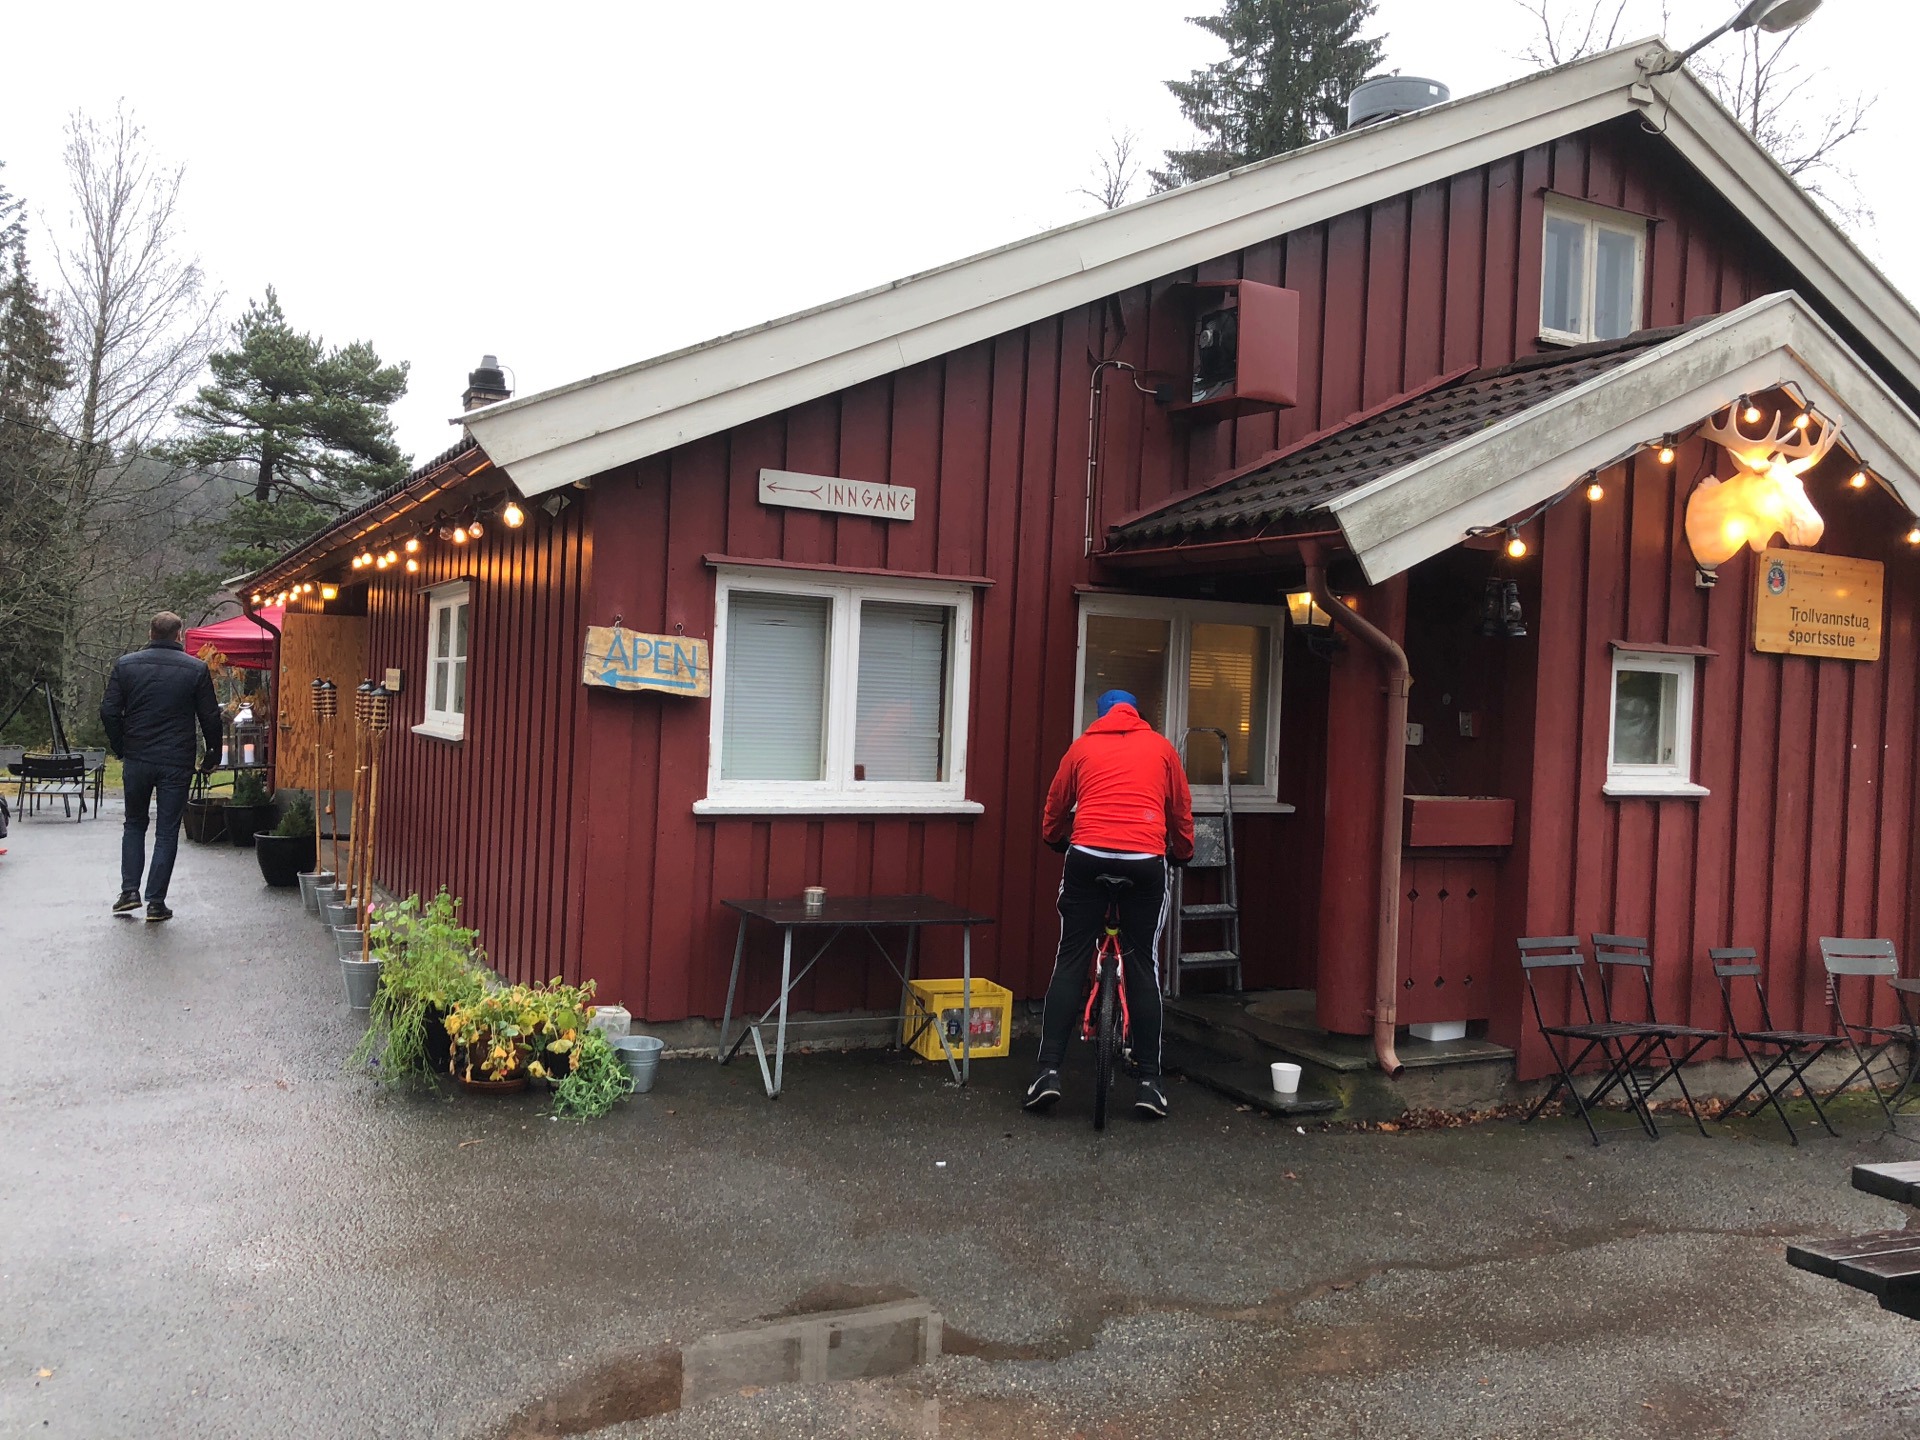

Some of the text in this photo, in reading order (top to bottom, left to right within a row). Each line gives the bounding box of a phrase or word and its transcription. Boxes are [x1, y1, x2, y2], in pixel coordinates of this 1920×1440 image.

[827, 483, 911, 512] INNGANG
[1789, 606, 1870, 629] Trollvannstua
[1788, 630, 1855, 648] sportsstue
[602, 627, 698, 679] ÅPEN
